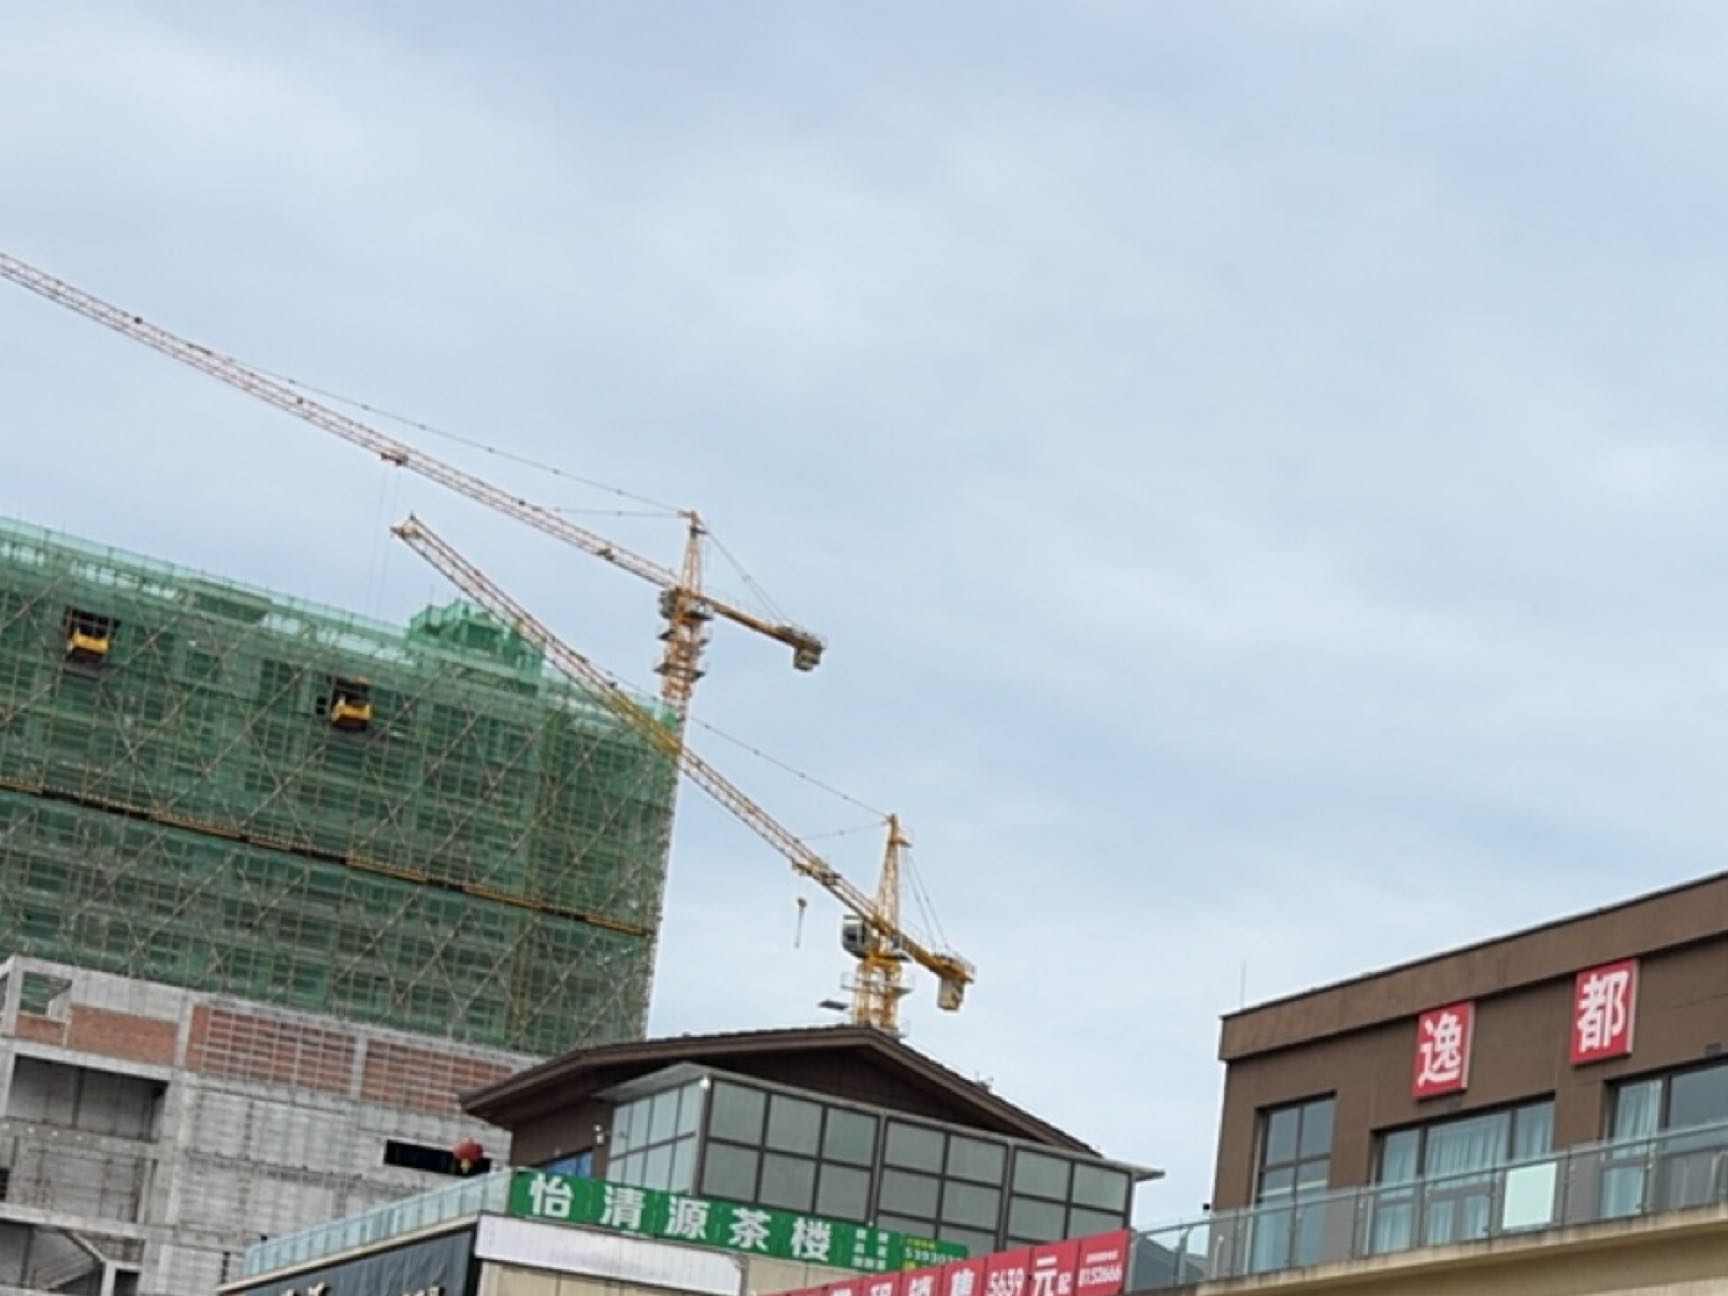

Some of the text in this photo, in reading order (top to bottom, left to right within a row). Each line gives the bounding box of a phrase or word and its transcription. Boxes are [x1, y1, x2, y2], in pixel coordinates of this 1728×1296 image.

[529, 1173, 833, 1264] 怡清源茶楼
